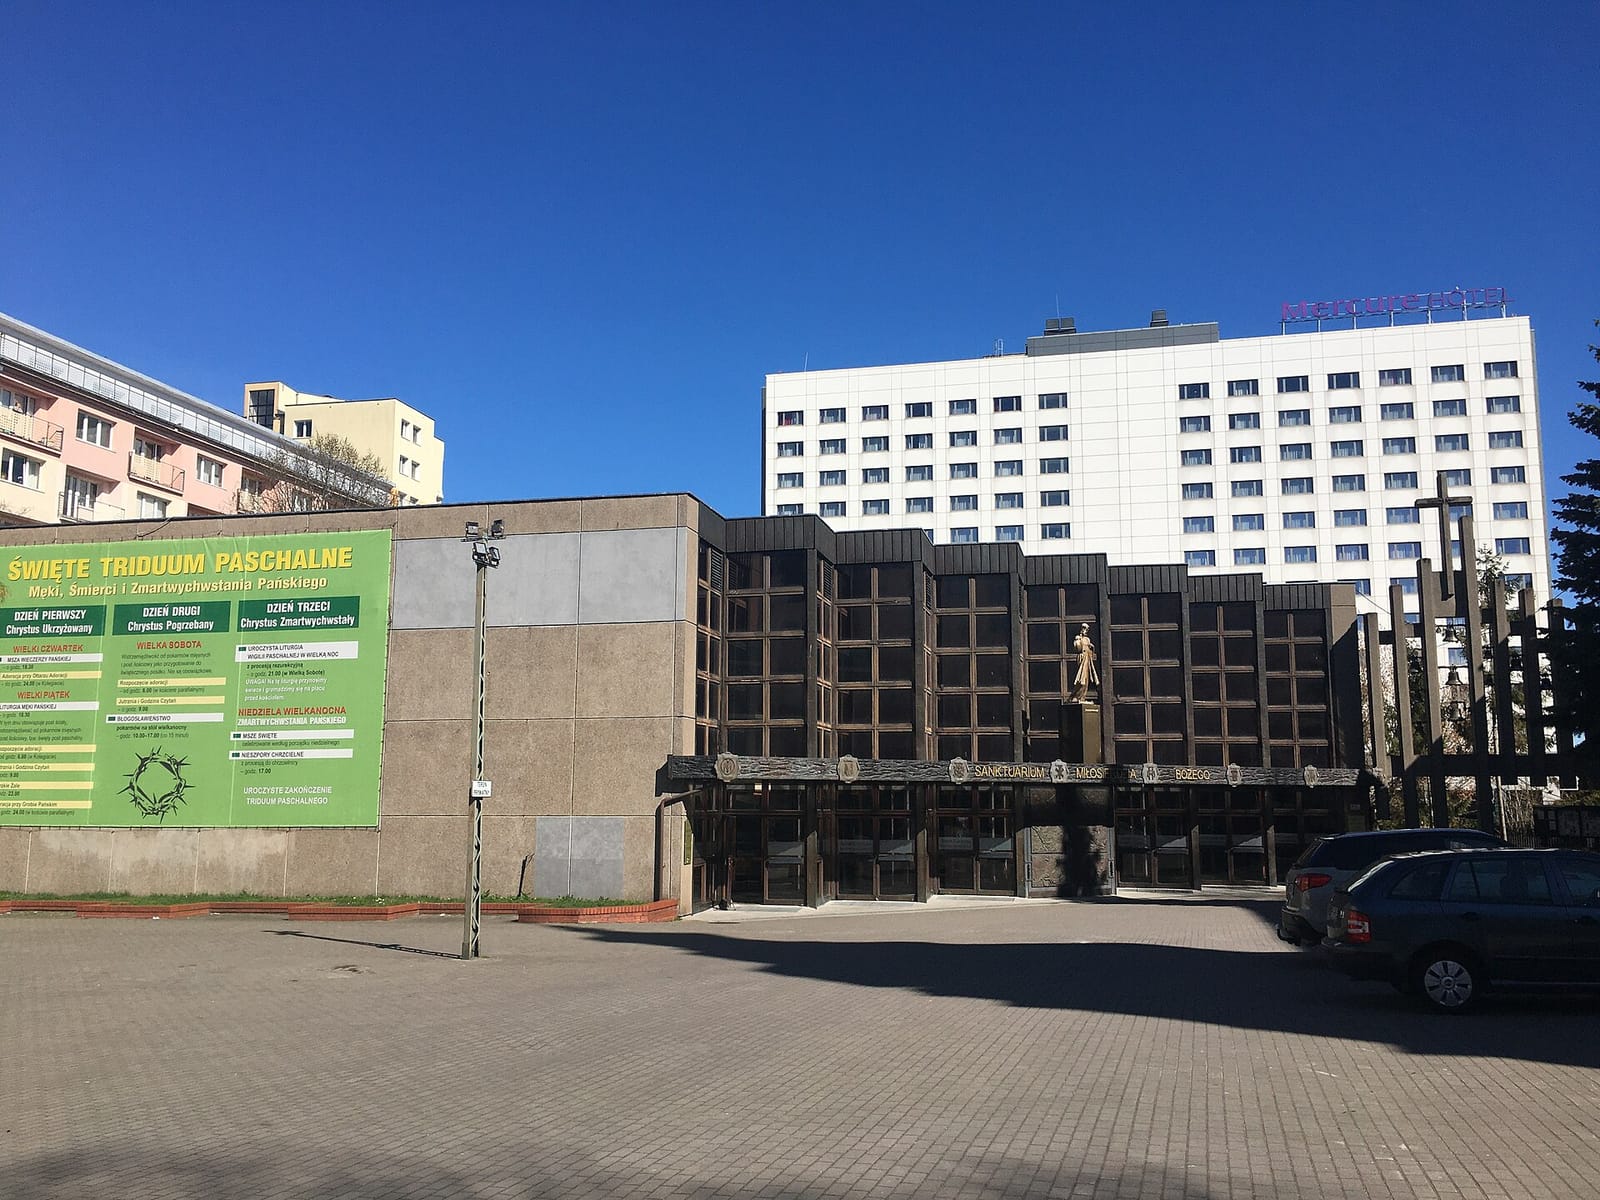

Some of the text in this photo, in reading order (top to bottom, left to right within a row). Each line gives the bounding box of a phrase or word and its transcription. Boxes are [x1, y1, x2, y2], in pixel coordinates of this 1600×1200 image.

[1282, 293, 1421, 320] Mercure
[7, 546, 353, 583] ŚWIĘTE TRIDUUM PASCHALNE
[29, 576, 328, 599] Męki, Śmierci i Zmartwychwstania Pańskiego
[143, 604, 201, 618] DZIEŃ DRUGI
[267, 600, 330, 613] DZIEŃ TRZECI
[14, 608, 87, 621] DZIEŃ PIERWSZY
[127, 619, 214, 632] Chrystus Pogrzebany
[240, 615, 355, 629] Chrystus Zmartwychwstały
[6, 623, 93, 635] Chrystus Ukrzyżowany
[13, 644, 84, 653] WIELKI CZWARTEK
[137, 641, 202, 649] WIELKA SOBOTA
[17, 691, 70, 699] WIELKI PIĄTEK
[238, 706, 346, 716] NIEDZIELA WIELKANOCNA
[237, 717, 308, 726] ZMARTWYCHWSTANIA
[974, 765, 1045, 778] SANKTUARIUM
[1076, 767, 1137, 779] MIŁOSIA
[243, 785, 333, 794] UROCZYSTE ZAKOŃCZENIE
[247, 796, 328, 805] TRIDUUM PASCHALNEGO
